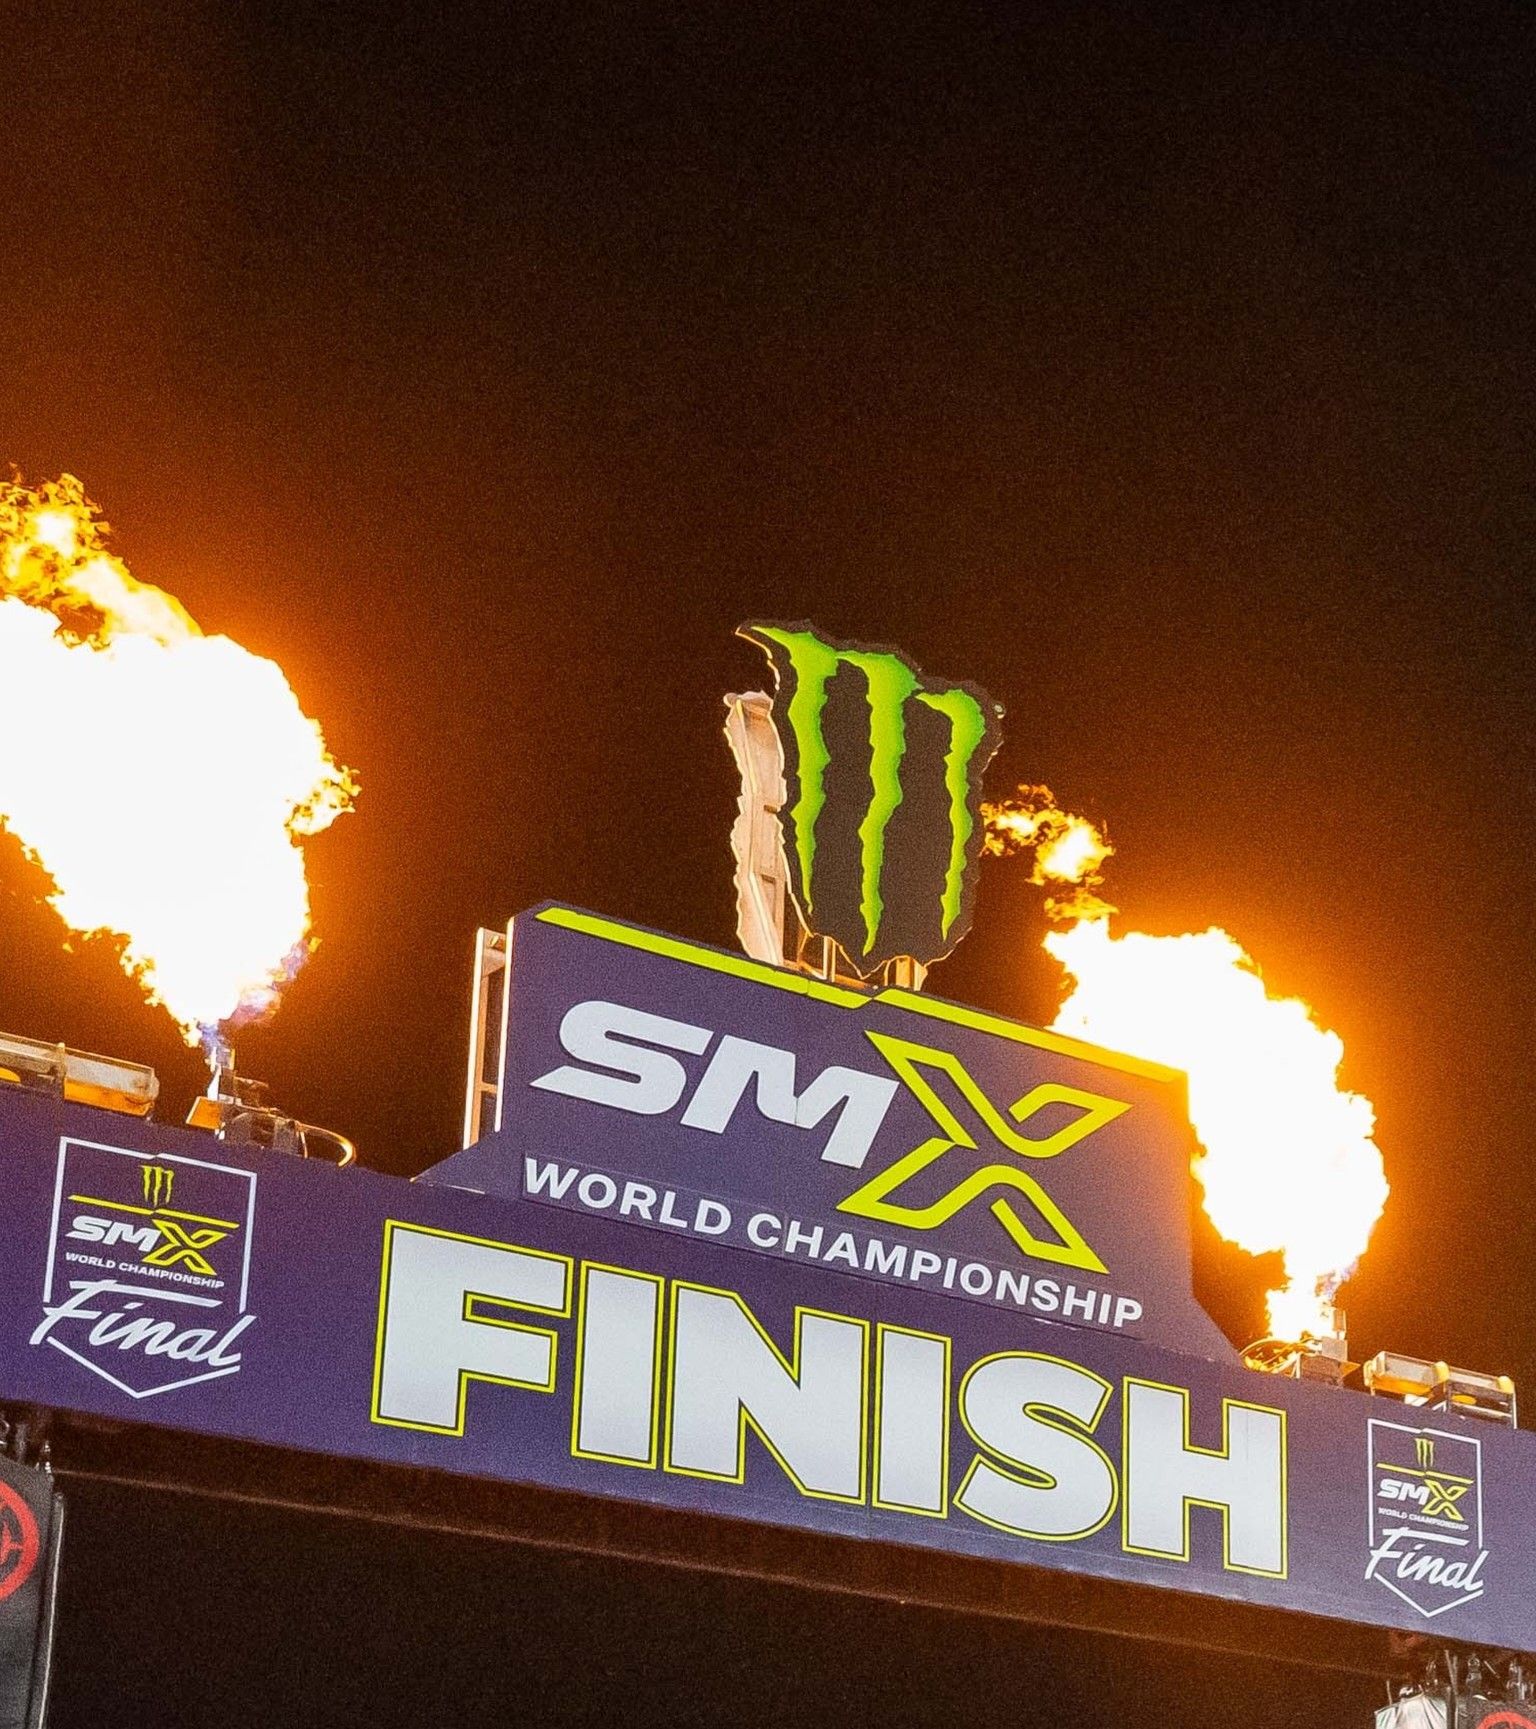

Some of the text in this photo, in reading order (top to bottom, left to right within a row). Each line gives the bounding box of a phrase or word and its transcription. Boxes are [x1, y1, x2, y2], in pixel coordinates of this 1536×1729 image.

[531, 1001, 1132, 1275] SMX
[65, 1214, 228, 1276] SMX
[65, 1252, 225, 1289] WORLD CHAMPIONSHIP
[523, 1157, 1144, 1329] WORLD CHAMPIONSHIP
[29, 1279, 257, 1367] Final
[370, 1219, 1287, 1579] FINISH
[1377, 1478, 1468, 1521] SMX
[1378, 1507, 1408, 1519] WORLD
[1365, 1527, 1490, 1591] Final
